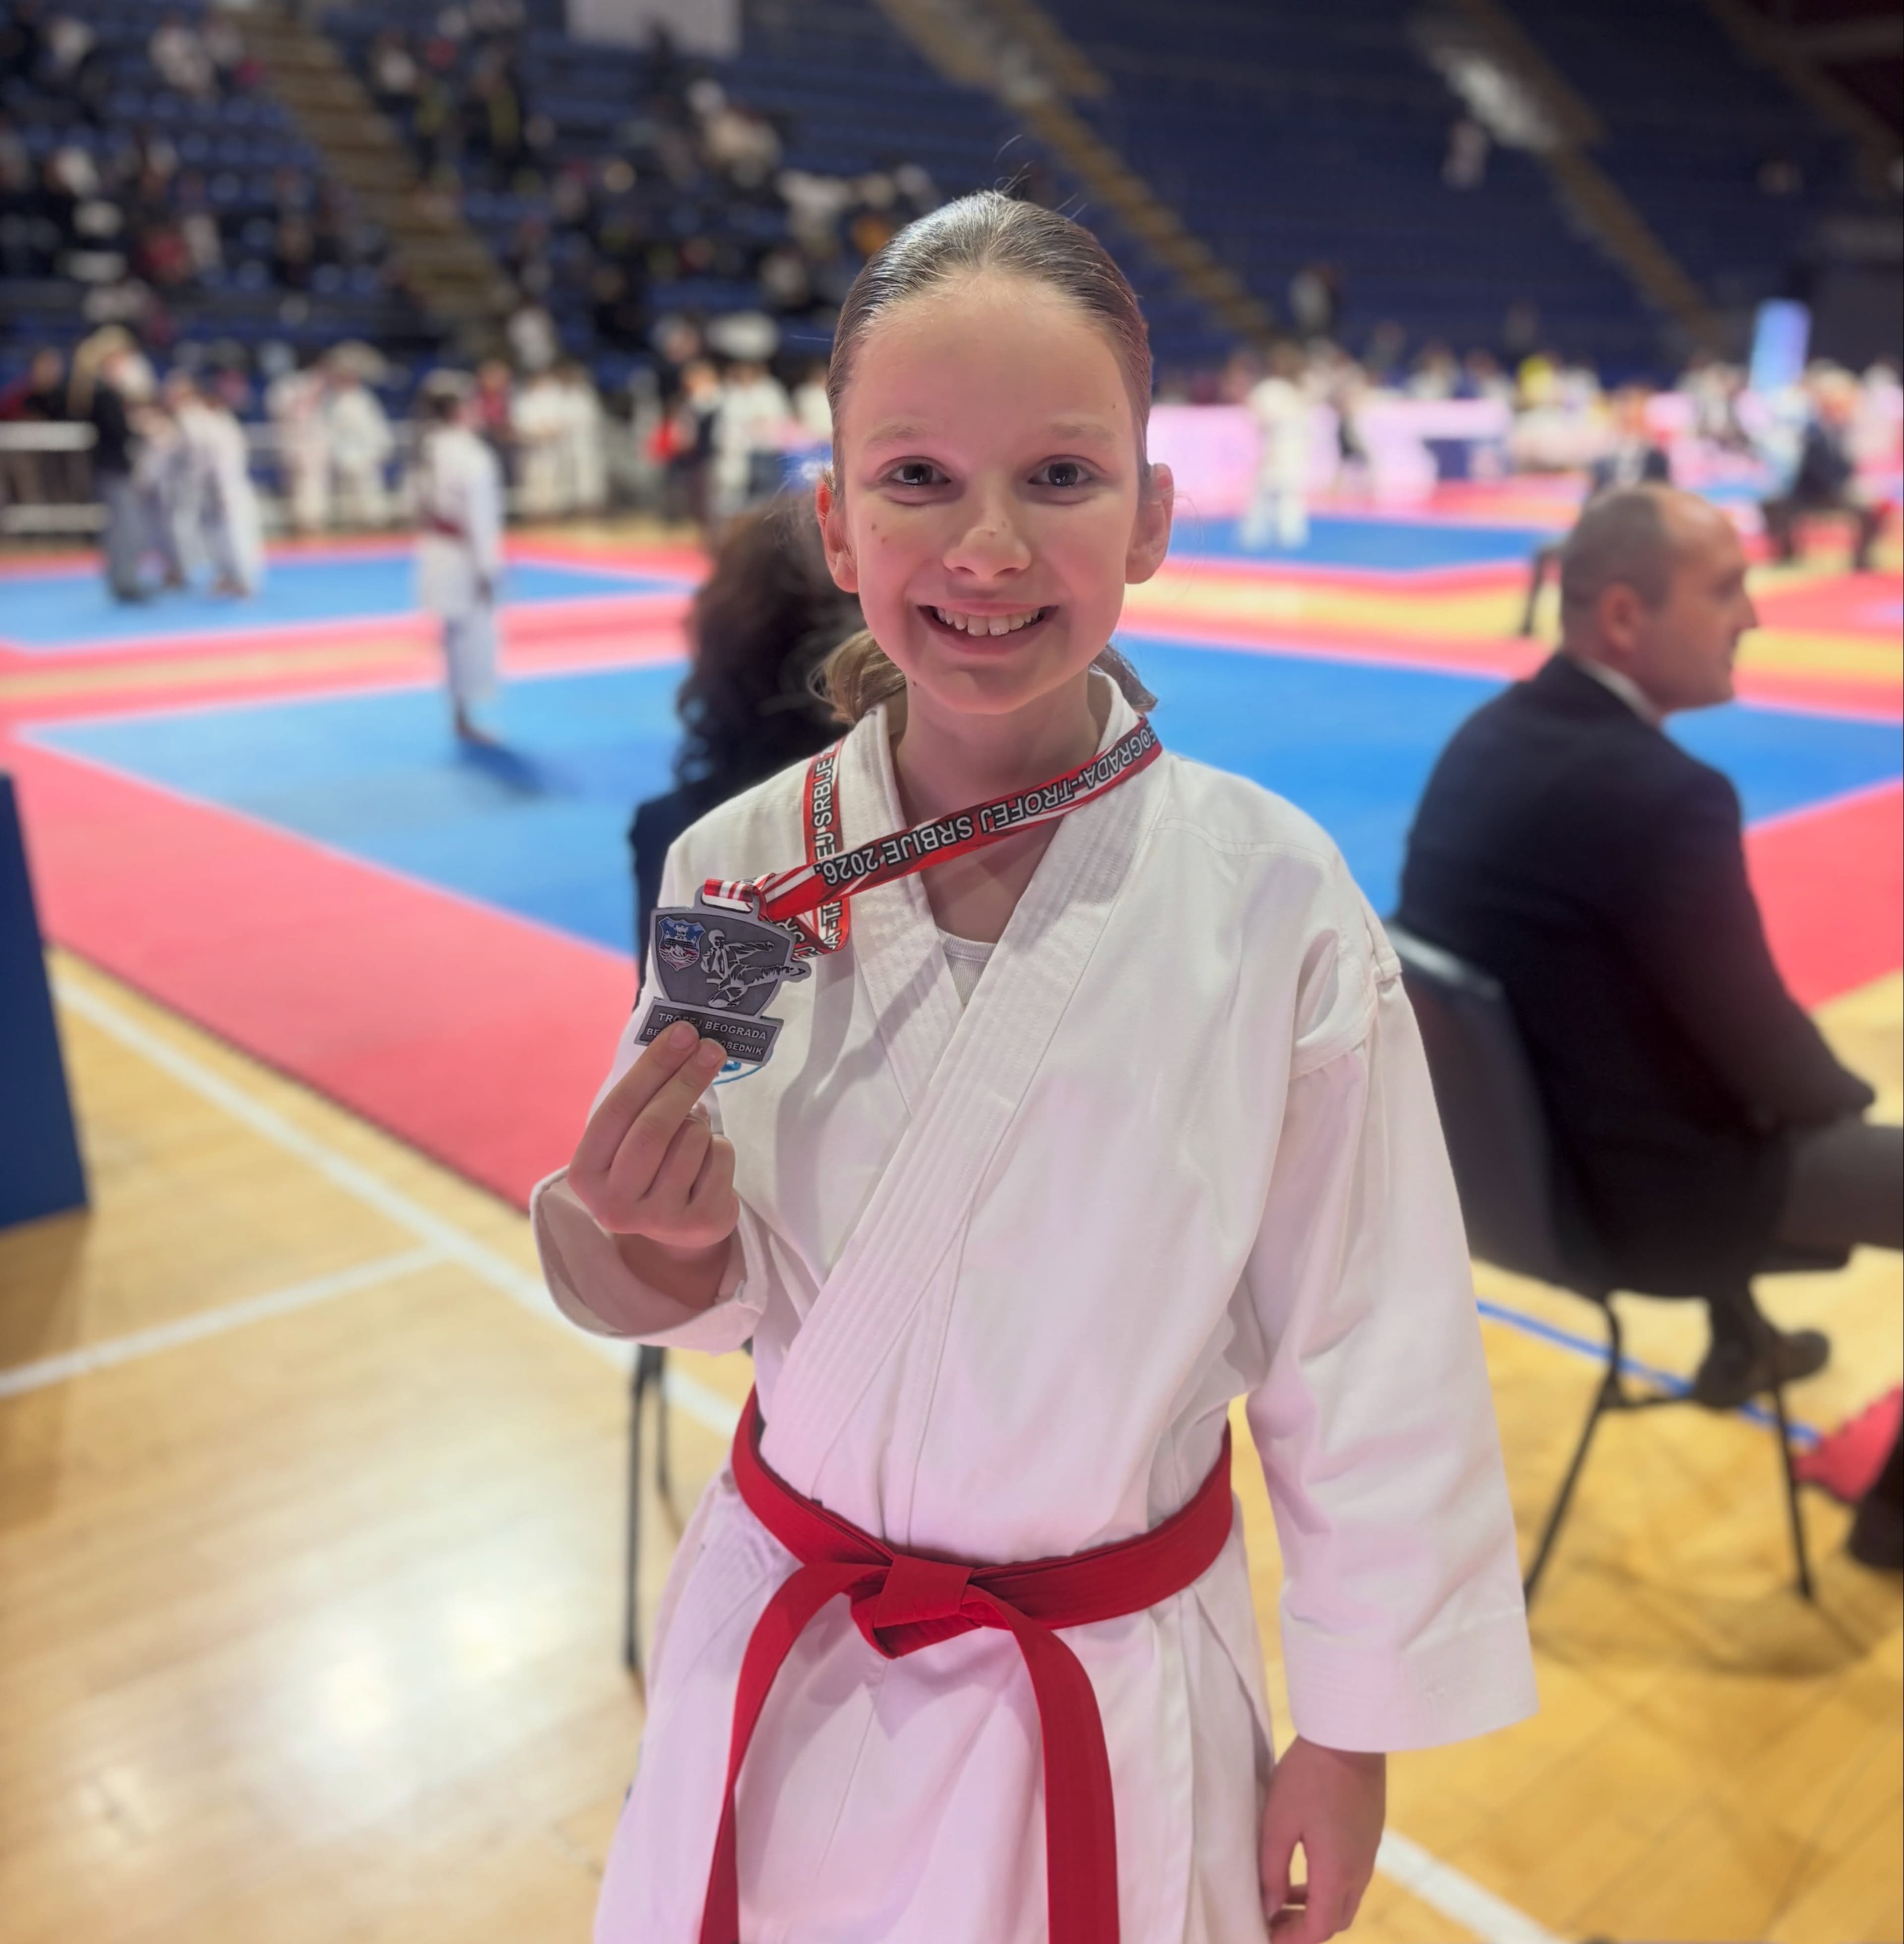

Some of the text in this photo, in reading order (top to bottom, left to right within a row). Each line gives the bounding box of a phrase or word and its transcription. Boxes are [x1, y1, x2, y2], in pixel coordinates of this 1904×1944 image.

[814, 757, 833, 827] SRBIJE
[883, 817, 973, 864] SRBIJE
[816, 848, 879, 884] 2026.
[705, 1021, 766, 1040] BEOGRADA
